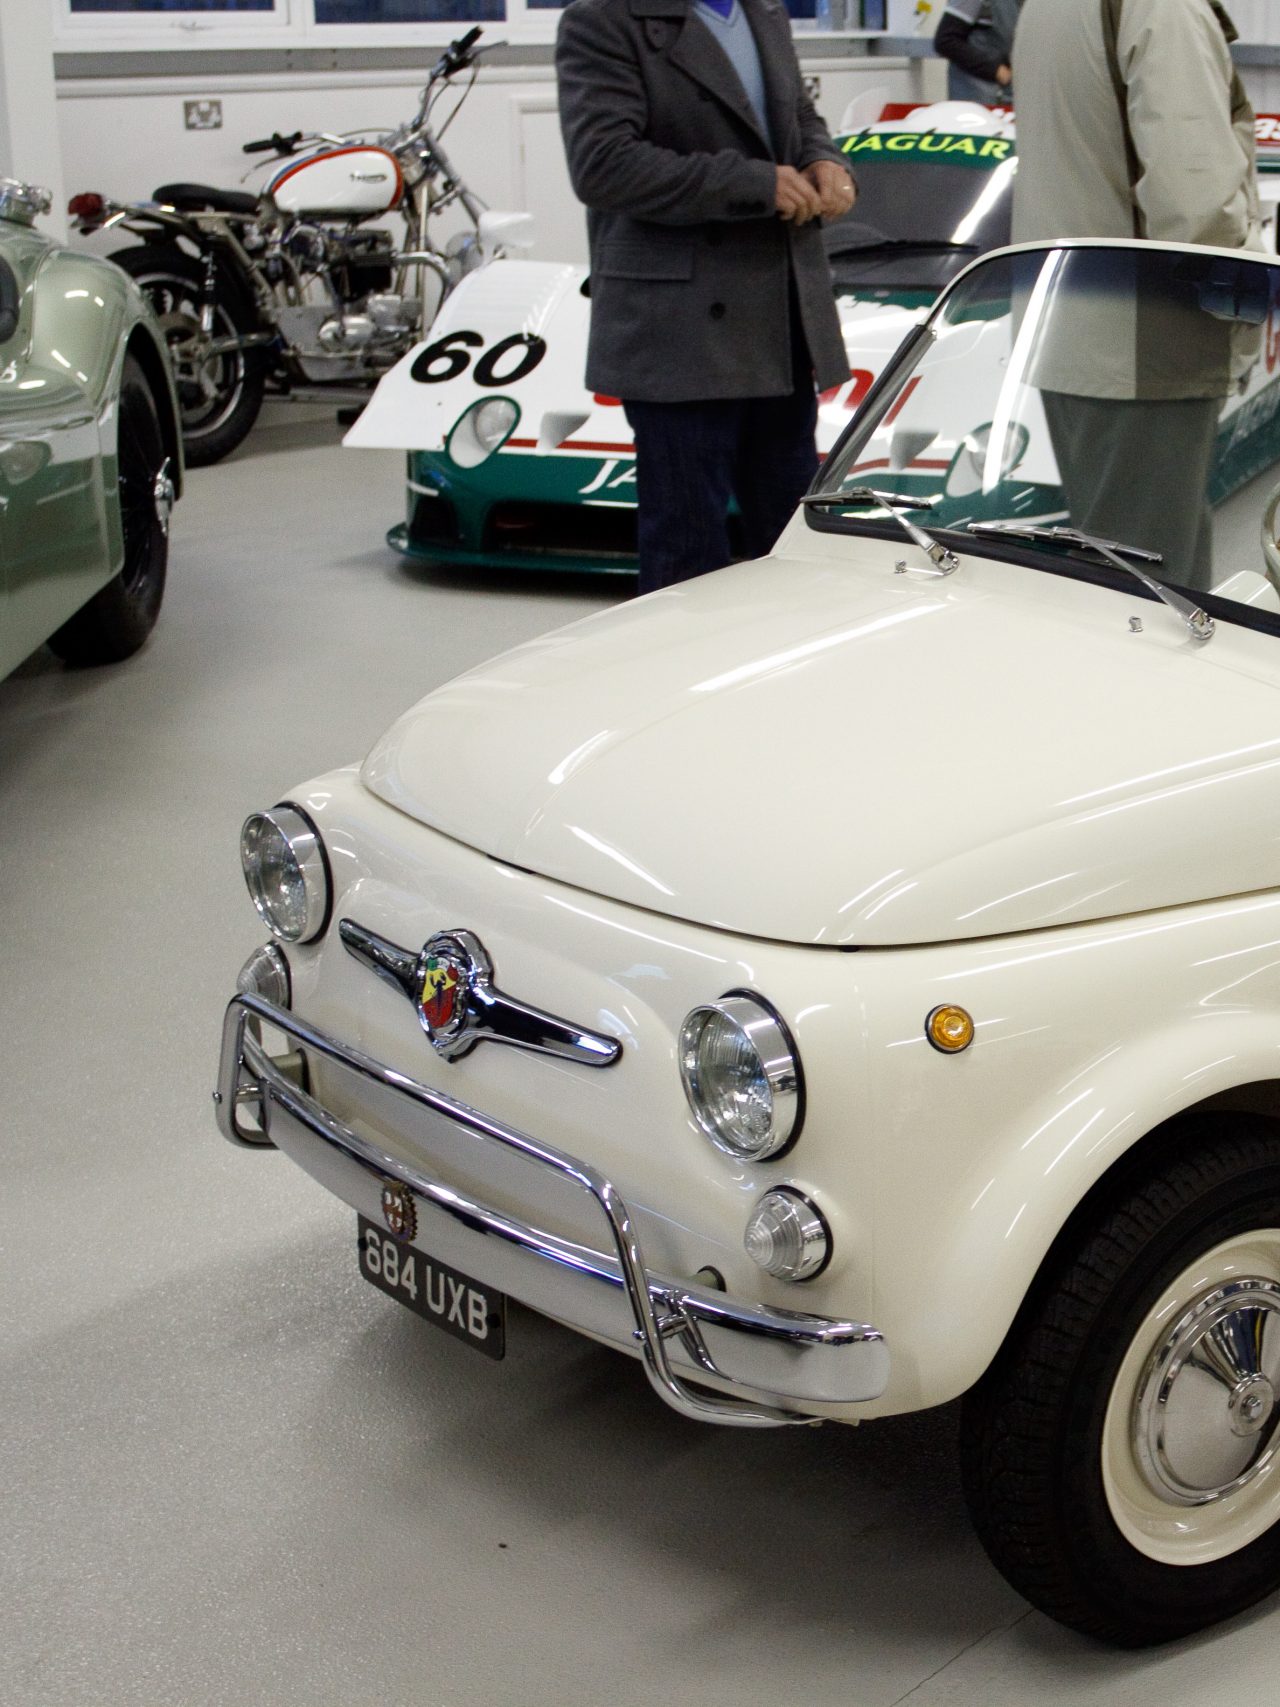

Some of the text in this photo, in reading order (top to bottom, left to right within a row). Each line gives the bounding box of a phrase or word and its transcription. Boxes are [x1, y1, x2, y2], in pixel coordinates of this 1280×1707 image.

[841, 134, 1011, 159] JAGUAR
[410, 330, 547, 387] 60
[365, 1228, 488, 1340] 684 UXB
